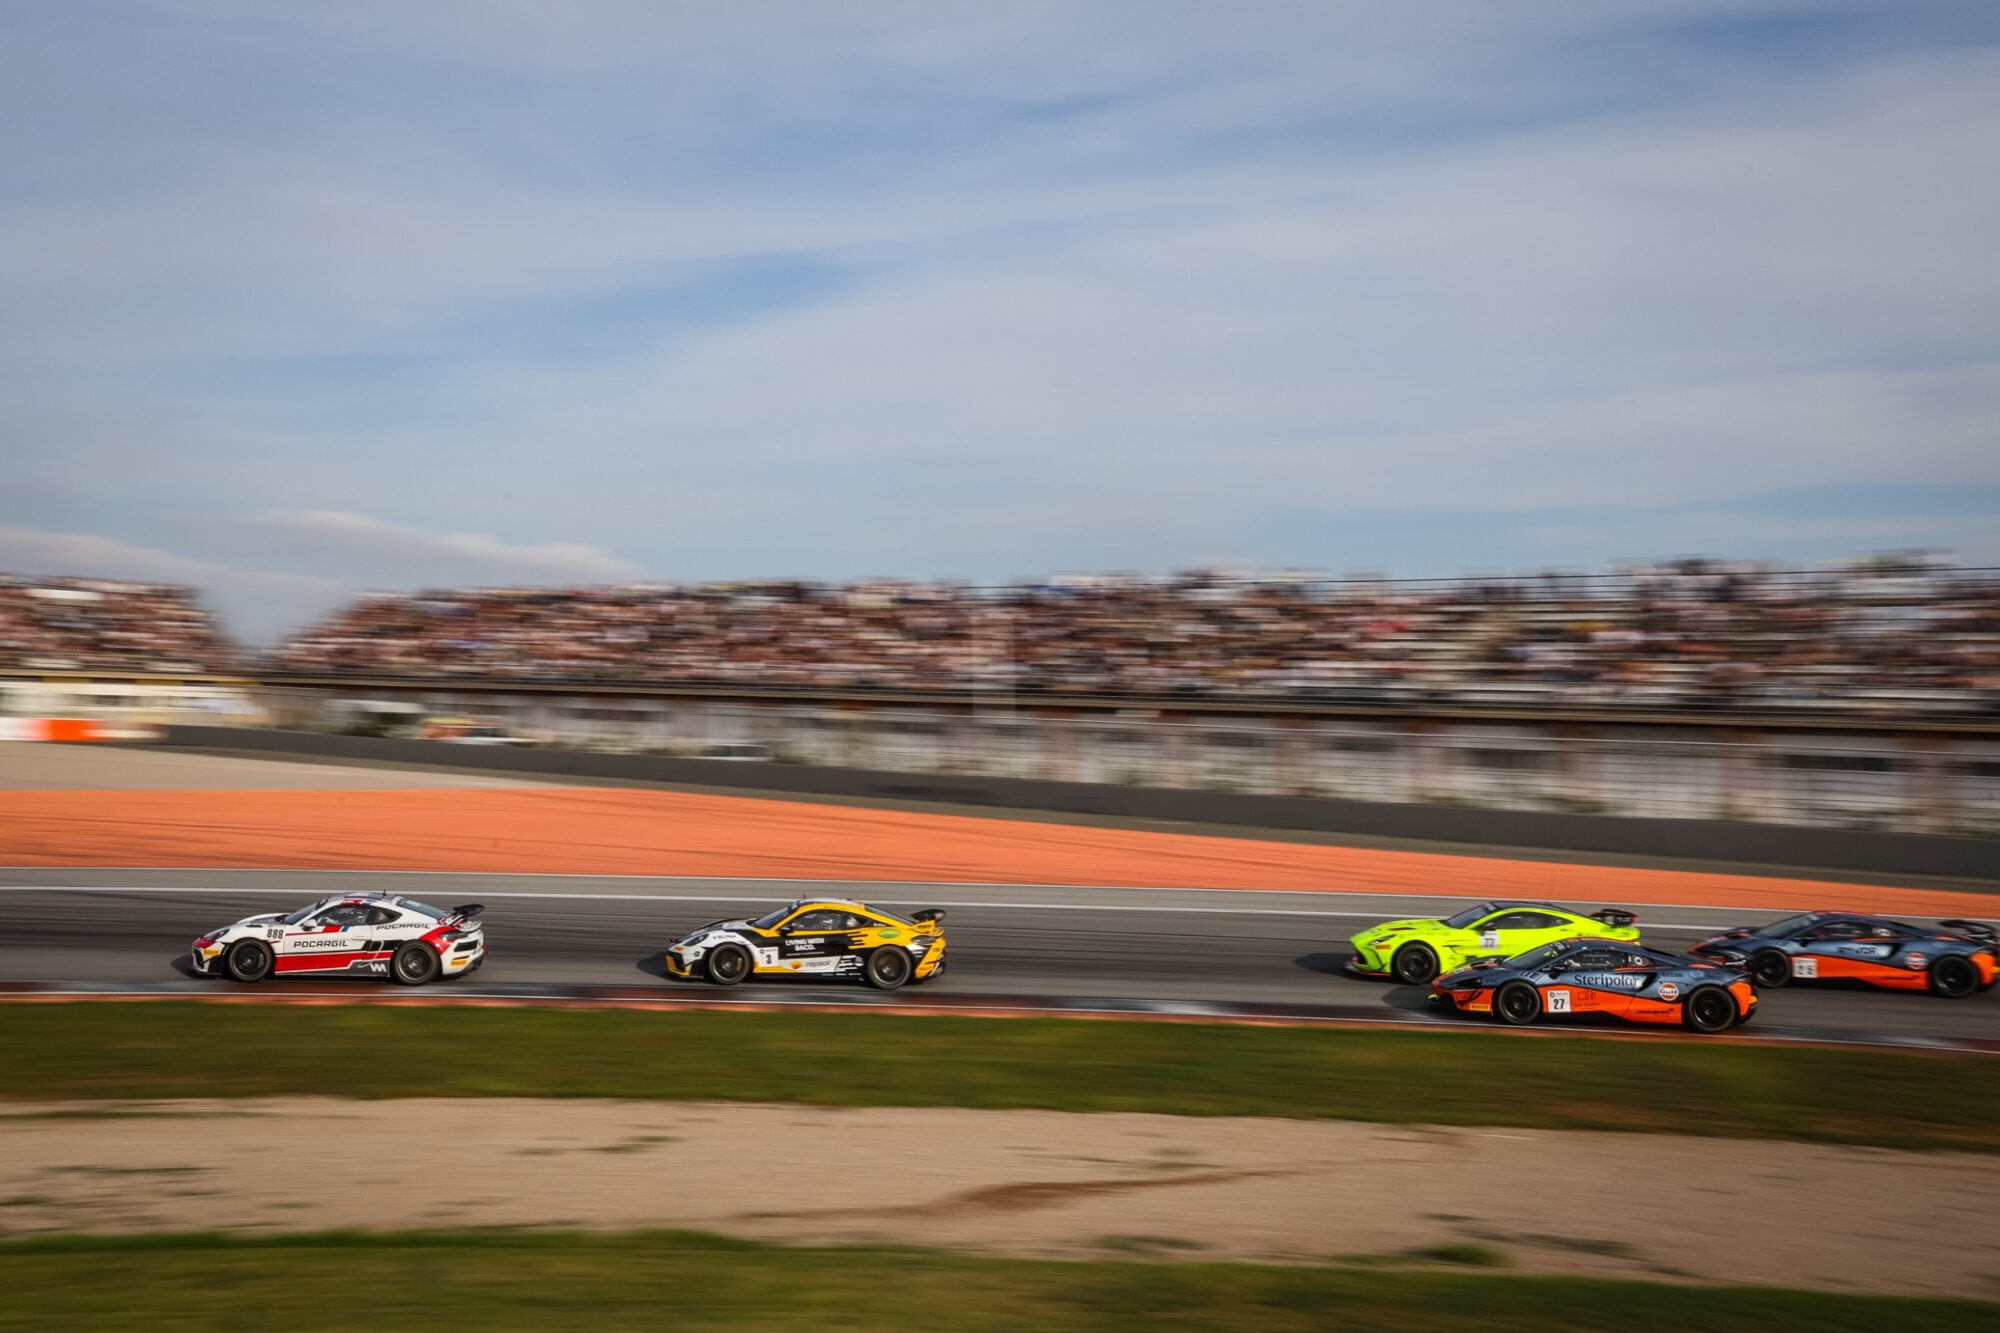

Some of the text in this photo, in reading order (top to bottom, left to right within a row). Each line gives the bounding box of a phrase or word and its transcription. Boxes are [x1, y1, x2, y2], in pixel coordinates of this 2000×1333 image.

[267, 928, 284, 940] 888
[293, 940, 349, 949] POCARGIL
[766, 954, 772, 964] 3
[1574, 974, 1640, 988] Steripolar
[1659, 987, 1678, 996] Gulf
[1553, 998, 1565, 1010] 27
